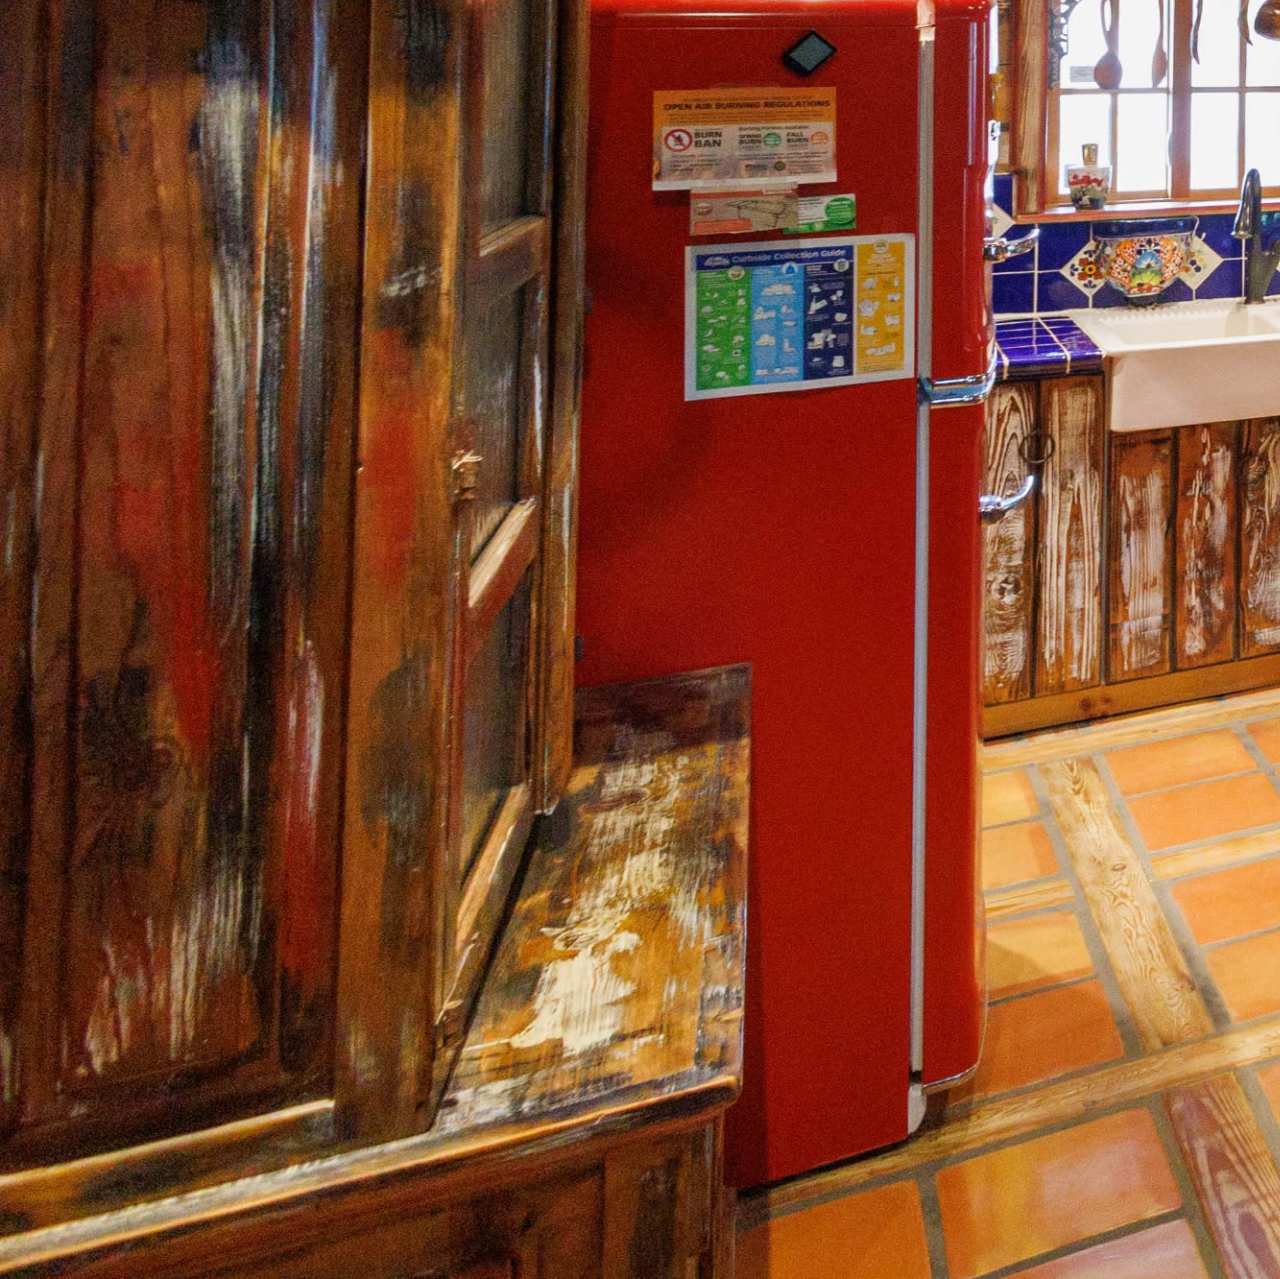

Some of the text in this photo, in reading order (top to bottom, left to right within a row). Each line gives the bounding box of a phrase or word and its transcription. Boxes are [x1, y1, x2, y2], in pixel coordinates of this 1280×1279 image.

[663, 103, 692, 111] OPEN
[694, 102, 713, 110] AIR
[714, 101, 761, 109] BURNING
[762, 99, 831, 108] REGULATIONS
[694, 131, 723, 139] BURN
[694, 139, 722, 148] BAN
[773, 251, 819, 261] Collection
[820, 248, 847, 258] Guide
